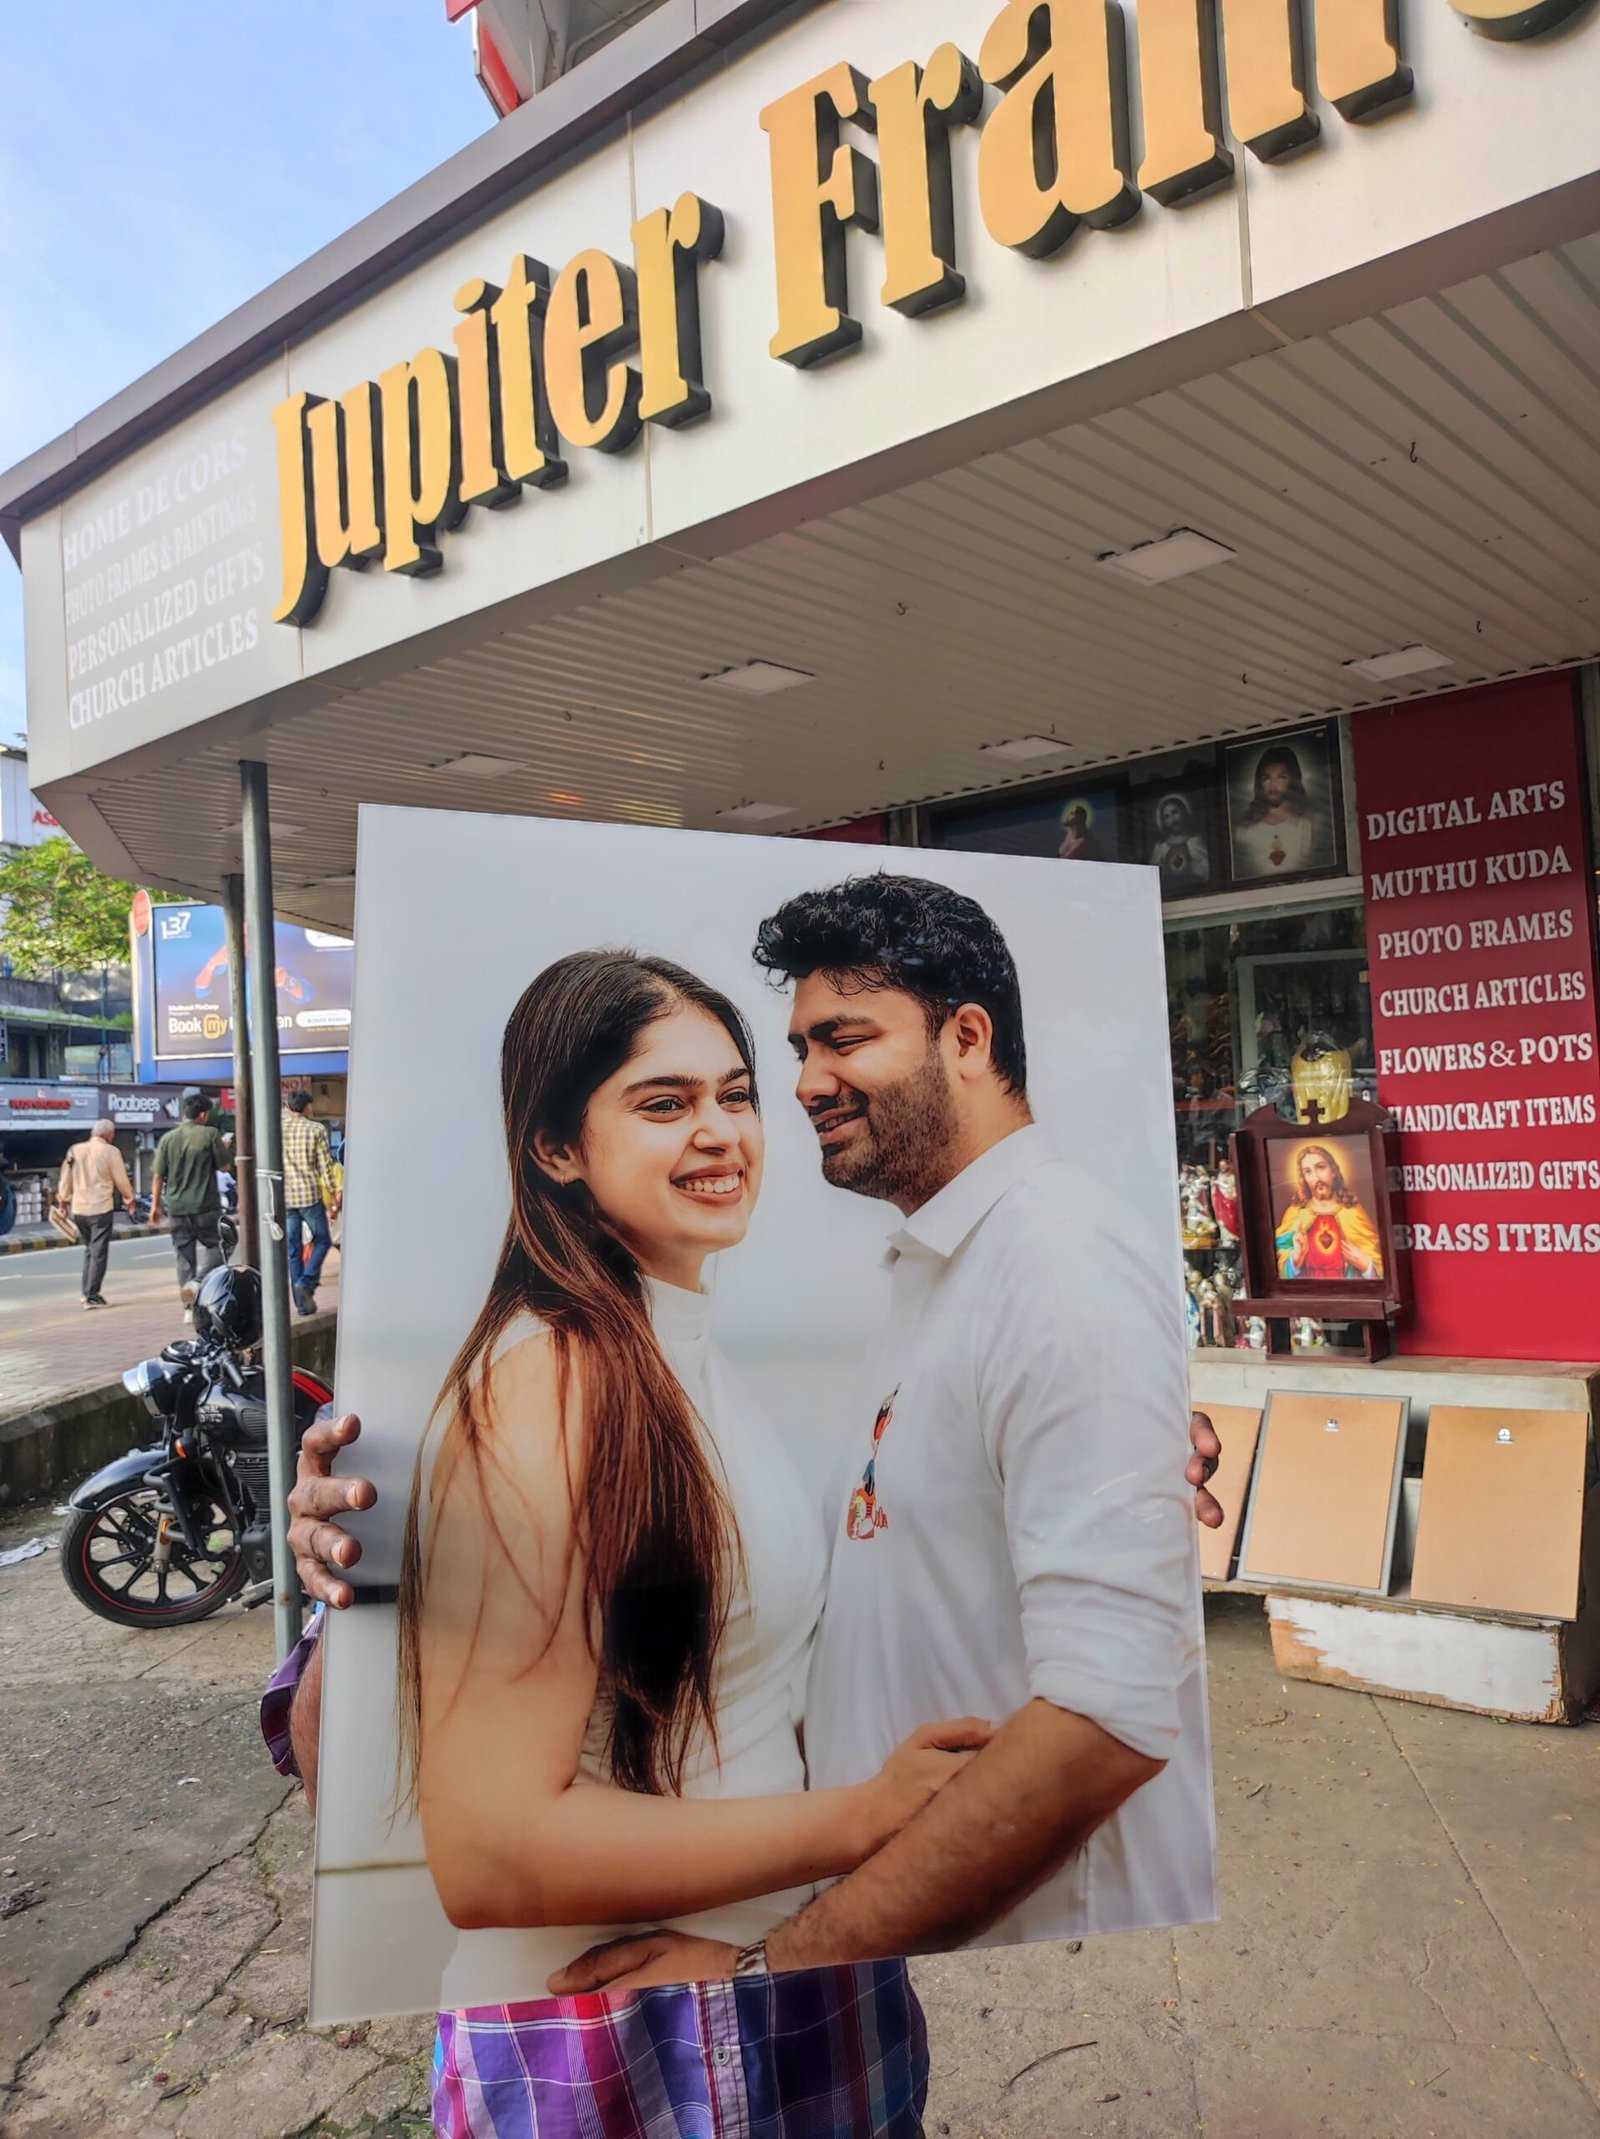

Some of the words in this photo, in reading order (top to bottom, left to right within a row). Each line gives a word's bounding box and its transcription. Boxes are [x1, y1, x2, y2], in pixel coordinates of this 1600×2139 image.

[271, 190, 708, 626] Jupiter
[759, 0, 1575, 362] Fram
[63, 499, 131, 572] HOME
[64, 574, 105, 627] PHOTO
[106, 545, 159, 601] FRAMES
[160, 535, 172, 572] &
[67, 577, 198, 681] PERSONALIZED
[203, 541, 264, 607] GIFTS
[68, 662, 146, 731] CHURCH
[150, 606, 259, 695] ARTICLES
[1366, 796, 1482, 841] DIGITAL
[1487, 780, 1566, 821] ARTS
[1370, 859, 1477, 900] MUTHU
[1485, 845, 1572, 885] KUDA
[1378, 923, 1463, 960] PHOTO
[1469, 908, 1574, 949] FRAMES
[1379, 982, 1470, 1018] CHURCH
[1474, 971, 1586, 1009] ARTICLES
[168, 1016, 202, 1034] Book
[1379, 1041, 1487, 1076] FLOWERS
[1489, 1040, 1516, 1068] &
[1519, 1033, 1593, 1065] POTS
[1525, 1094, 1596, 1128] ITEMS
[1387, 1161, 1534, 1192] PERSONALIZED
[1539, 1160, 1600, 1191] GIFTS
[1392, 1223, 1490, 1252] BRASS
[1497, 1222, 1600, 1253] ITEMS
